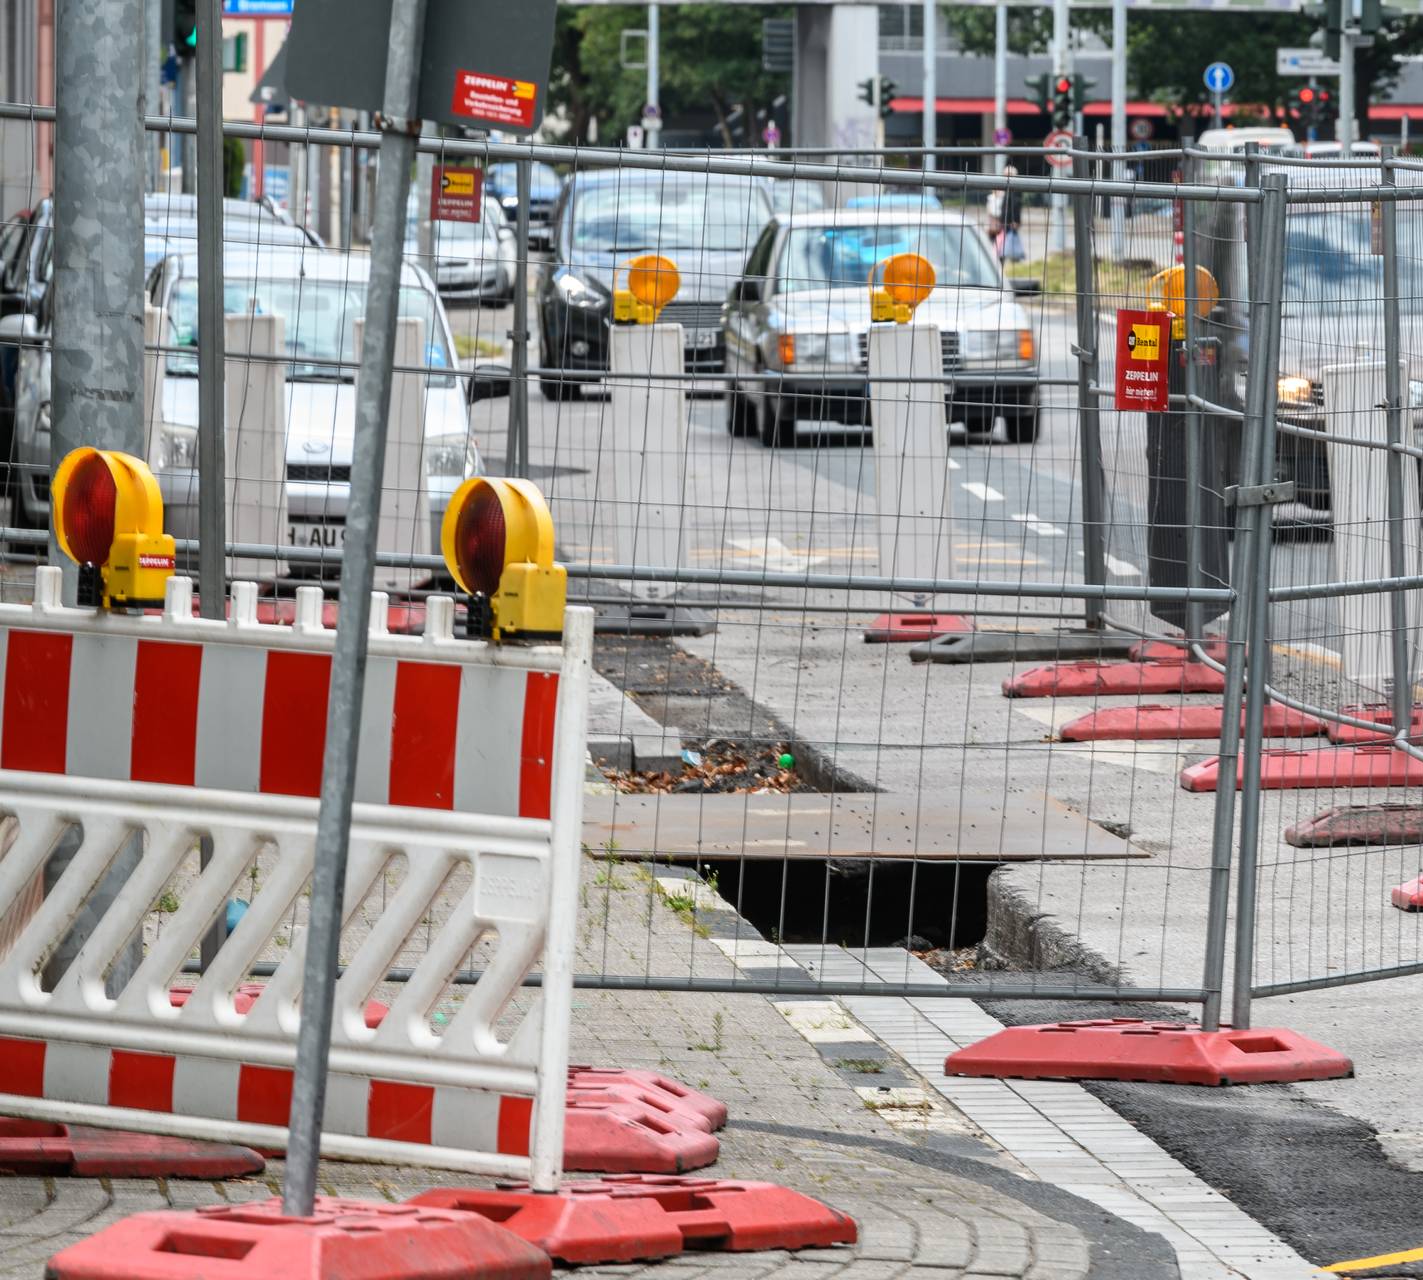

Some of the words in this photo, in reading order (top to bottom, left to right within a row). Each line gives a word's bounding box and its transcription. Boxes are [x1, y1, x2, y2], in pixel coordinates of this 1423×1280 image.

[464, 75, 508, 91] ZEPPELIN
[1136, 337, 1158, 347] Rental
[1125, 370, 1159, 382] ZEPPELIN
